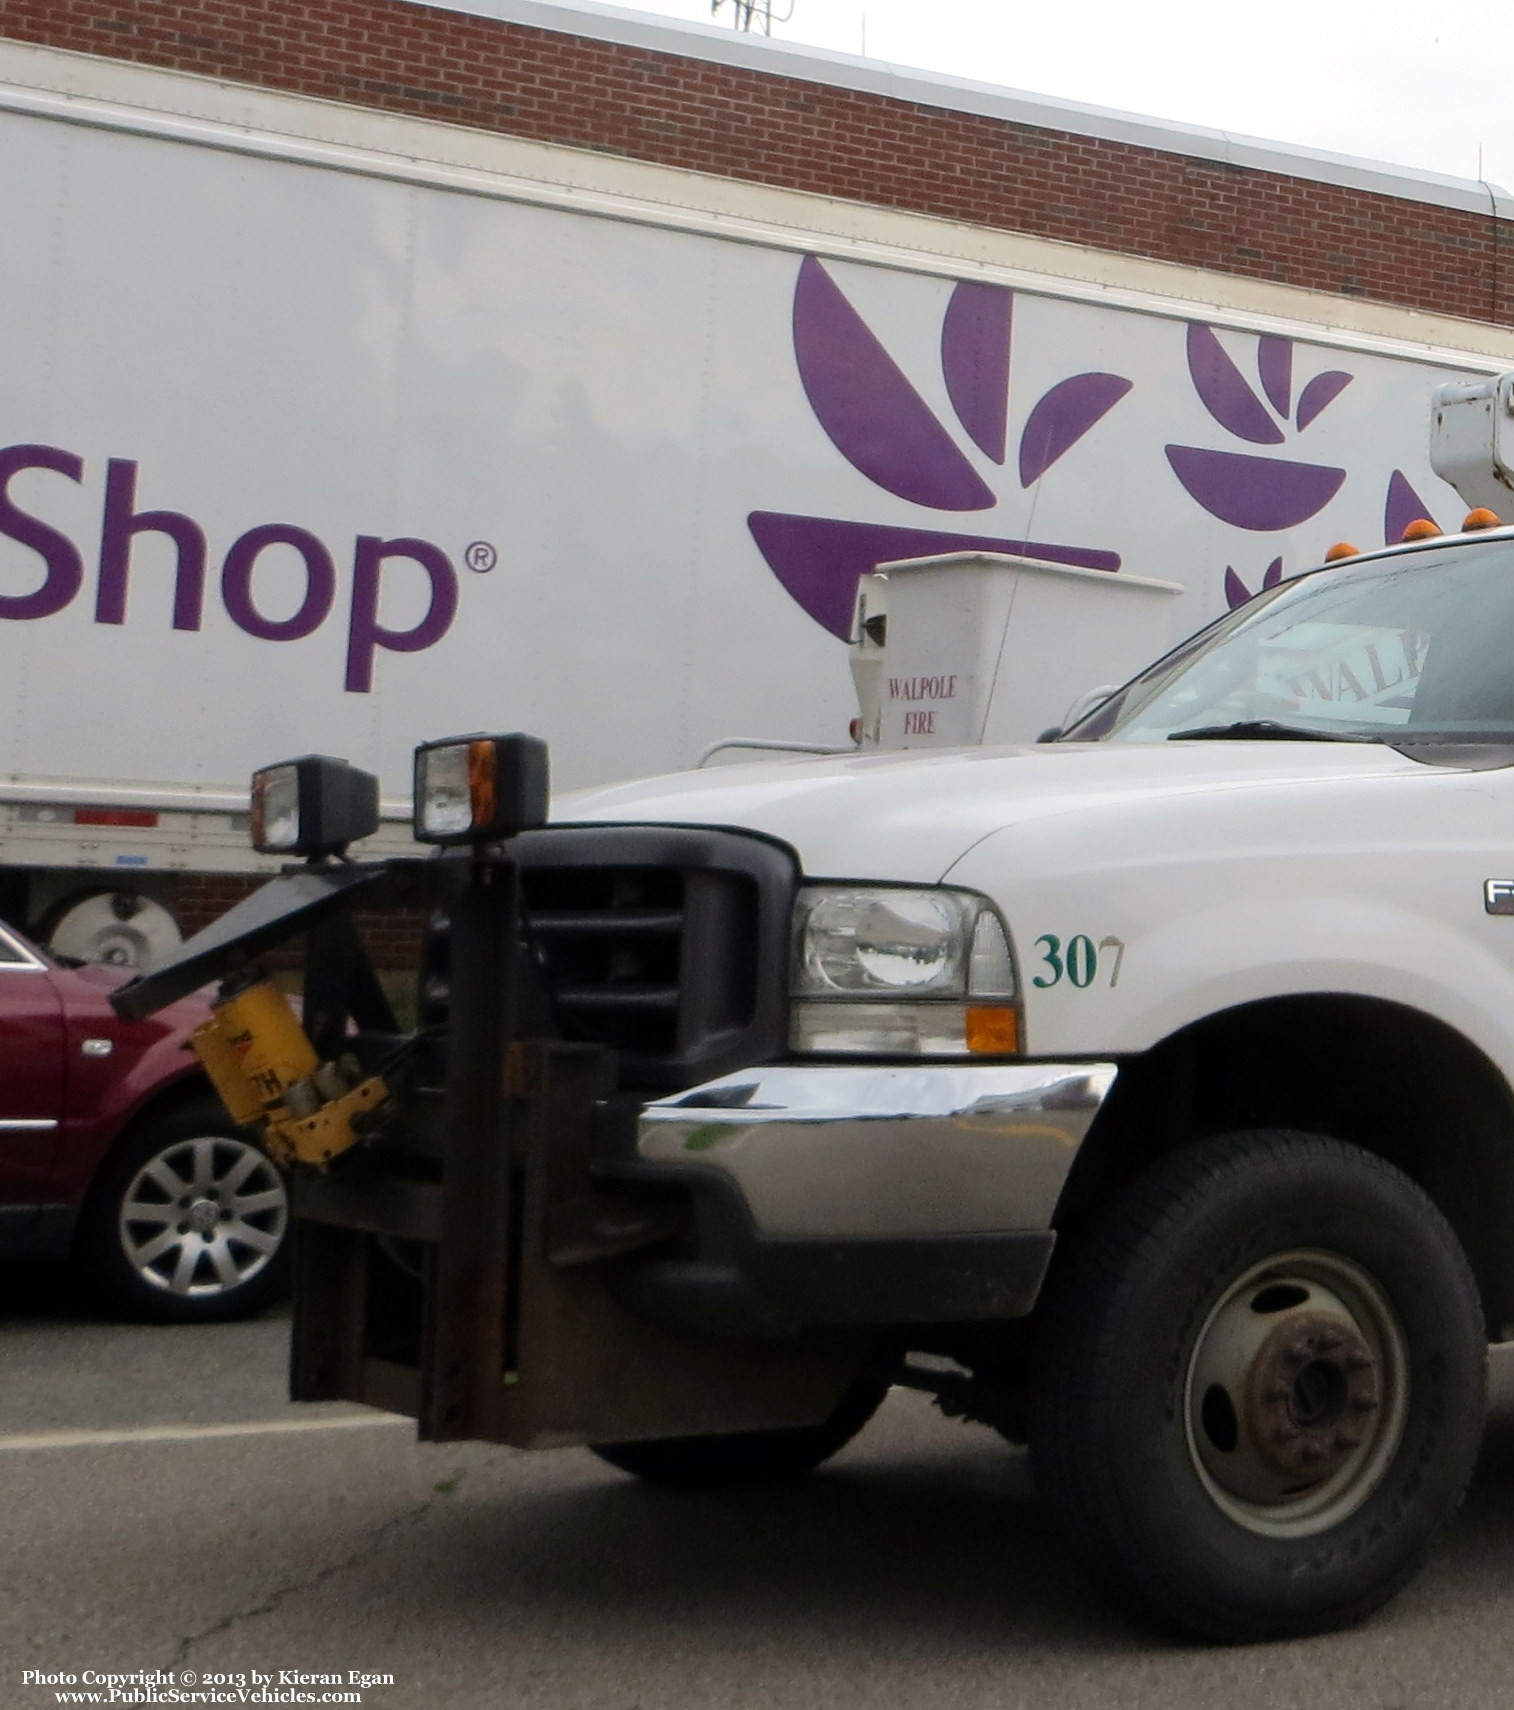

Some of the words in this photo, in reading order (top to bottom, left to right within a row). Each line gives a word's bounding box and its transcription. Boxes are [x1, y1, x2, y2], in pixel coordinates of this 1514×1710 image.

[887, 674, 958, 701] WALPOLE
[903, 710, 937, 735] FIRE
[1032, 933, 1126, 989] 307
